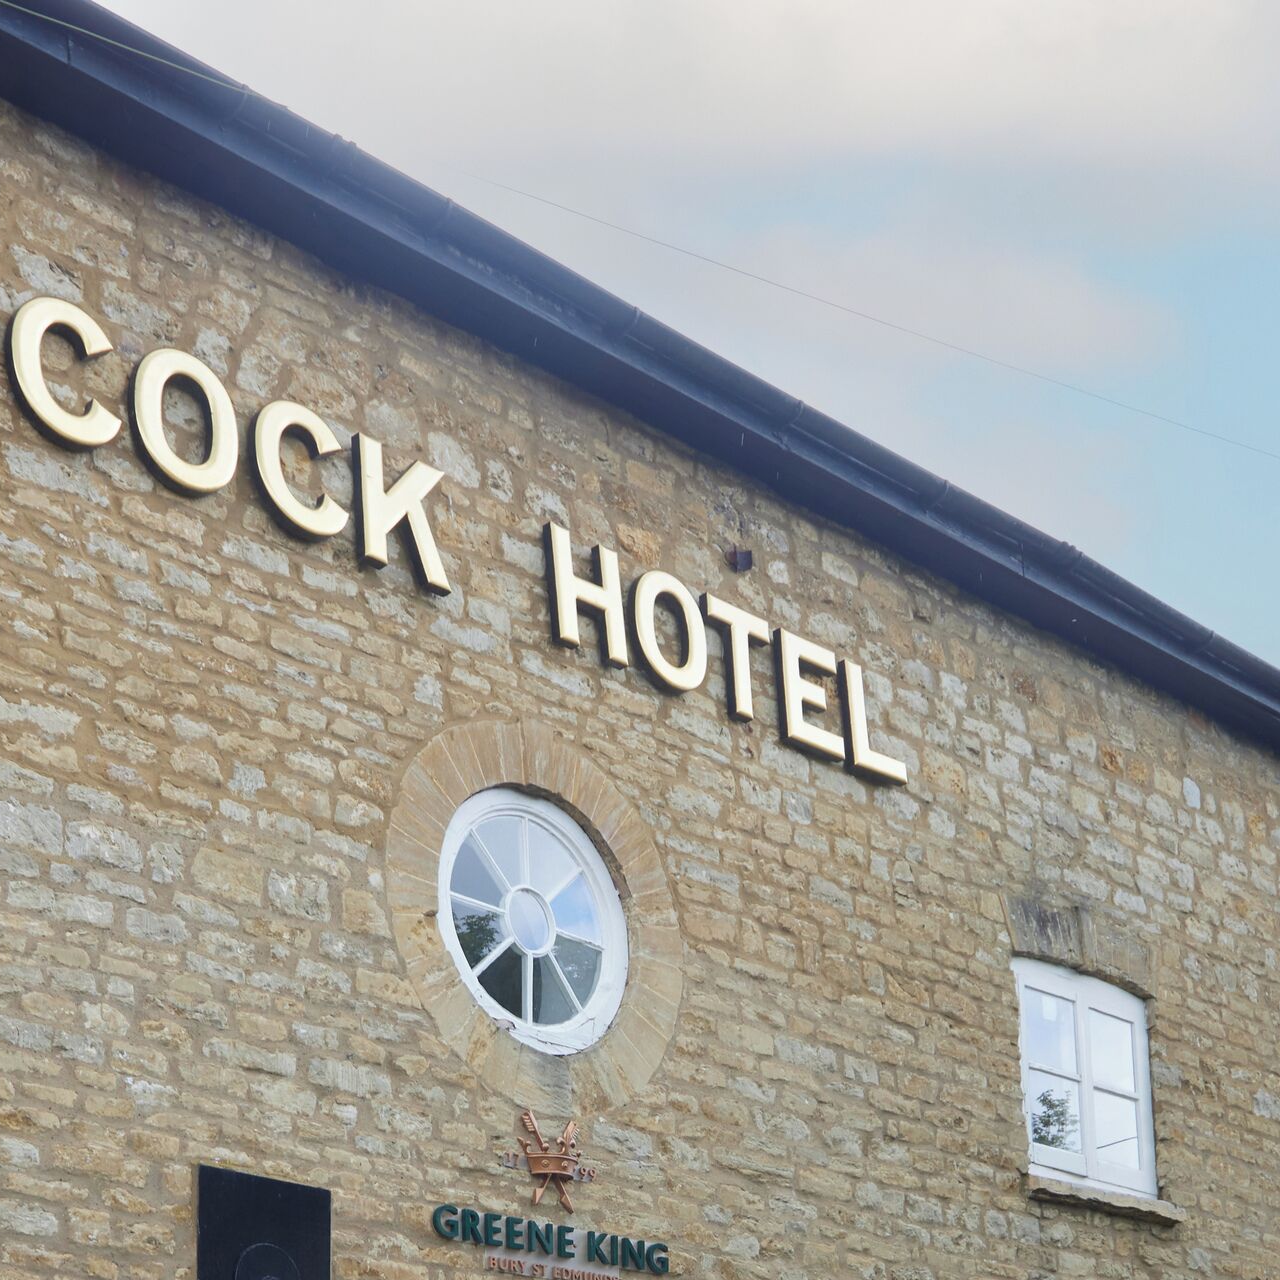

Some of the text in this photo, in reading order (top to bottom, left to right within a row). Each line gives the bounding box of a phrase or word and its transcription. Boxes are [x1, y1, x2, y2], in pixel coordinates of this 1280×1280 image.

[8, 296, 907, 786] COCK HOTEL
[432, 1204, 670, 1275] GREENE KING
[488, 1256, 526, 1273] BURY
[532, 1263, 548, 1277] ST
